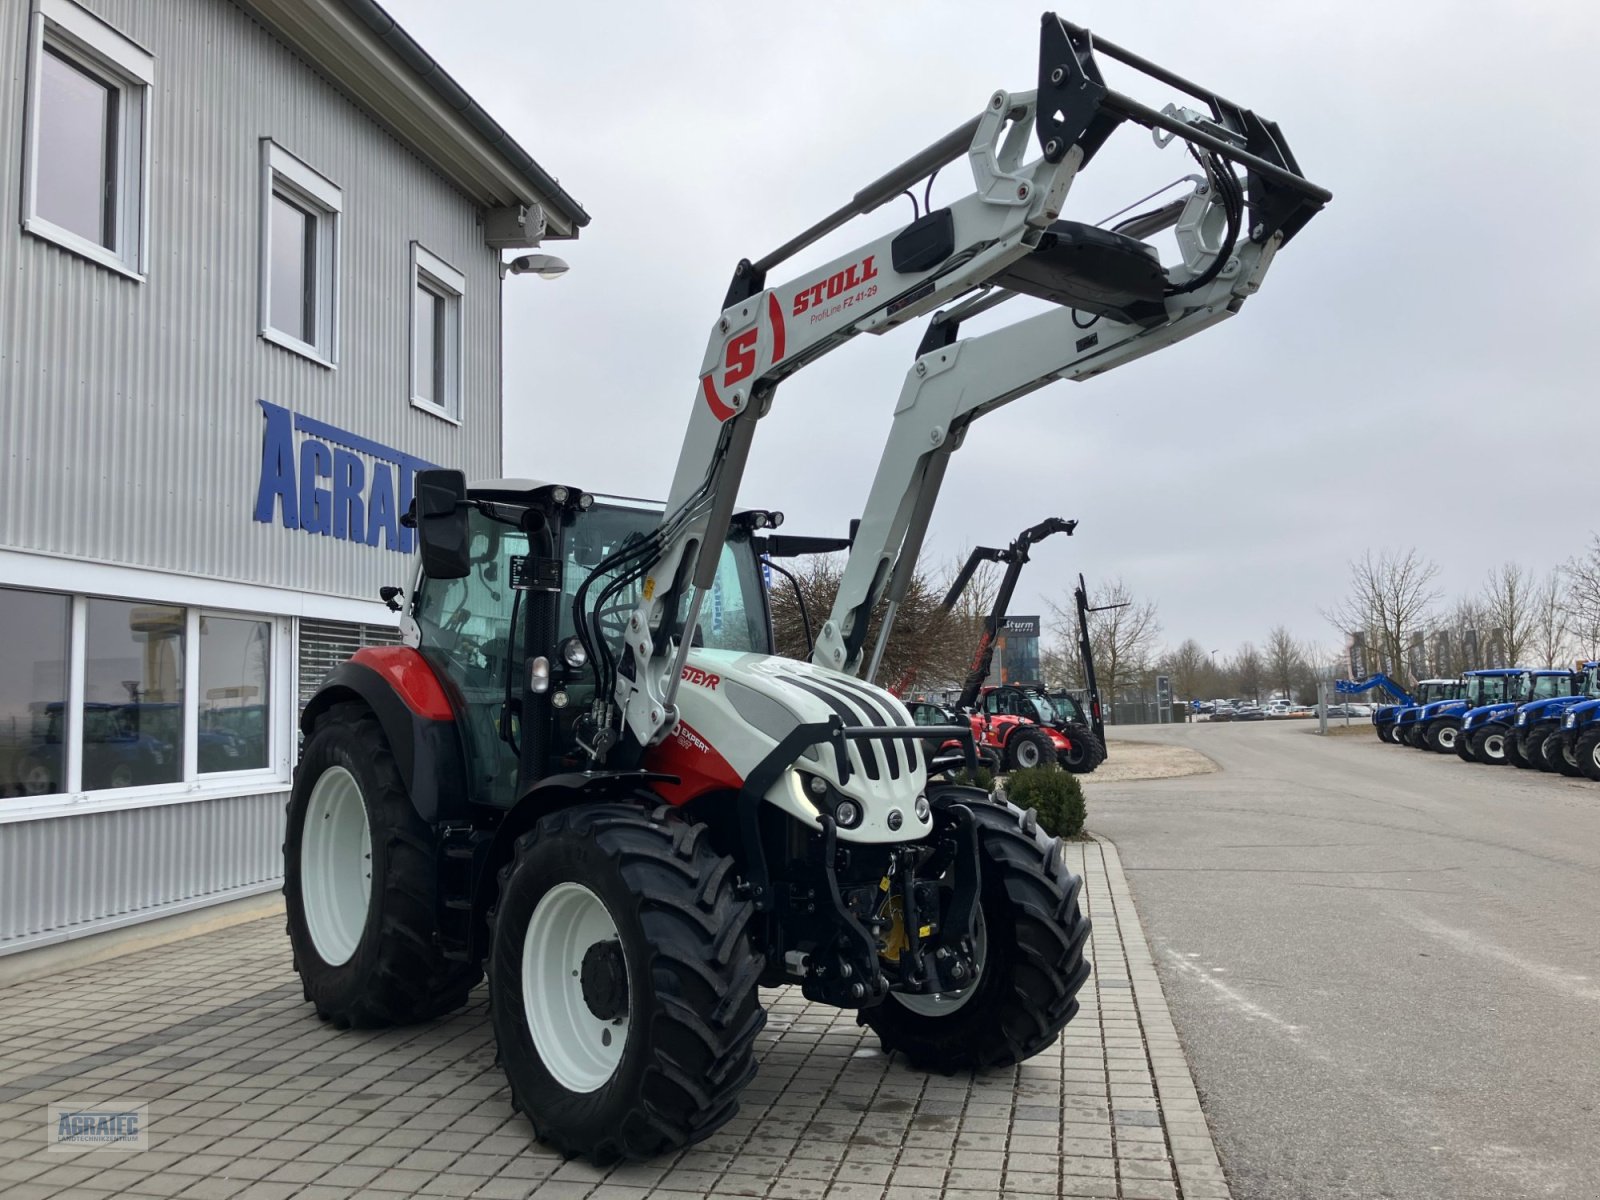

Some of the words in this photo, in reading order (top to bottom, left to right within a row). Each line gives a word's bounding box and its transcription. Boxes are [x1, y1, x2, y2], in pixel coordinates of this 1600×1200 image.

[793, 255, 878, 317] STOLL
[810, 303, 842, 325] ProfiLine
[843, 296, 854, 310] FZ
[855, 285, 878, 303] 41-29
[724, 327, 758, 388] S
[253, 399, 435, 555] AGRAT
[1004, 620, 1034, 629] Sturm
[681, 664, 720, 691] STEYR
[681, 727, 710, 754] EXPERT
